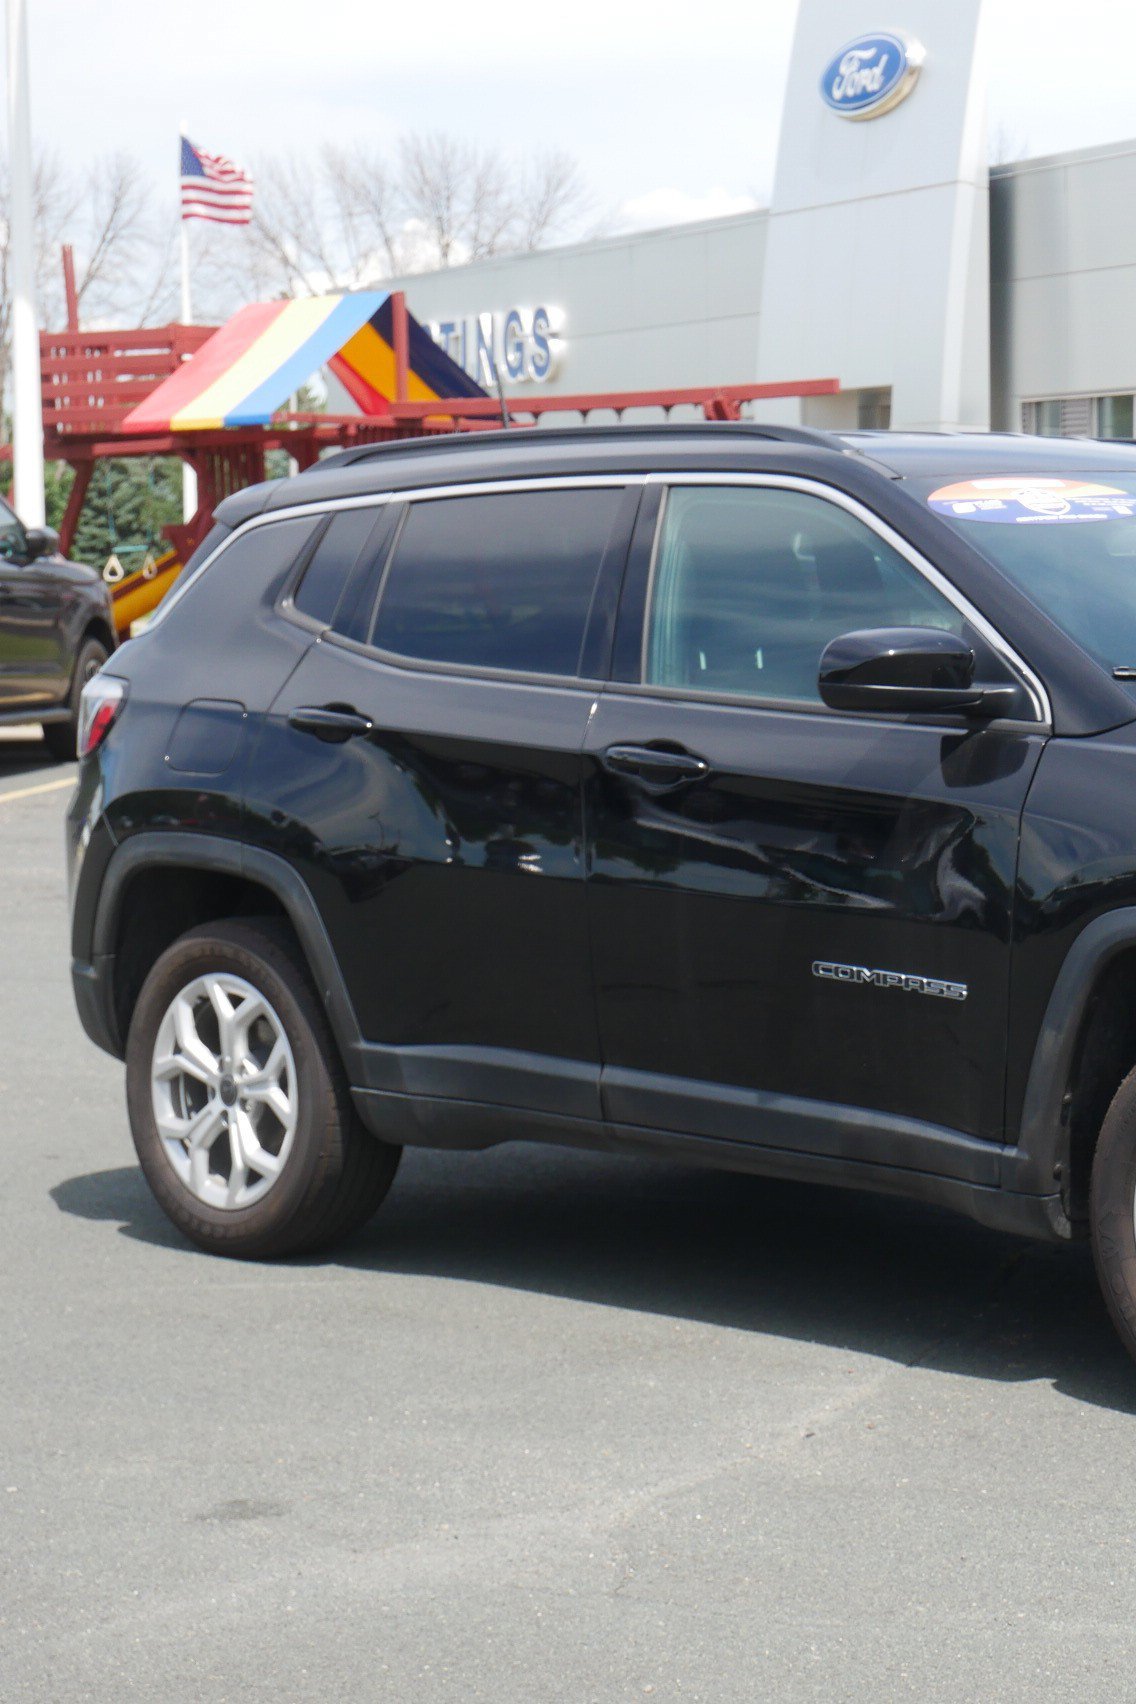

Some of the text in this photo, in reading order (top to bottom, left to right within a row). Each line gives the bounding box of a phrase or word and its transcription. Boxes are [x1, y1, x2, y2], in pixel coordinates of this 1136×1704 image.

[832, 47, 889, 101] Ford
[420, 303, 557, 384] TINGS
[811, 960, 968, 1000] COMPASS
